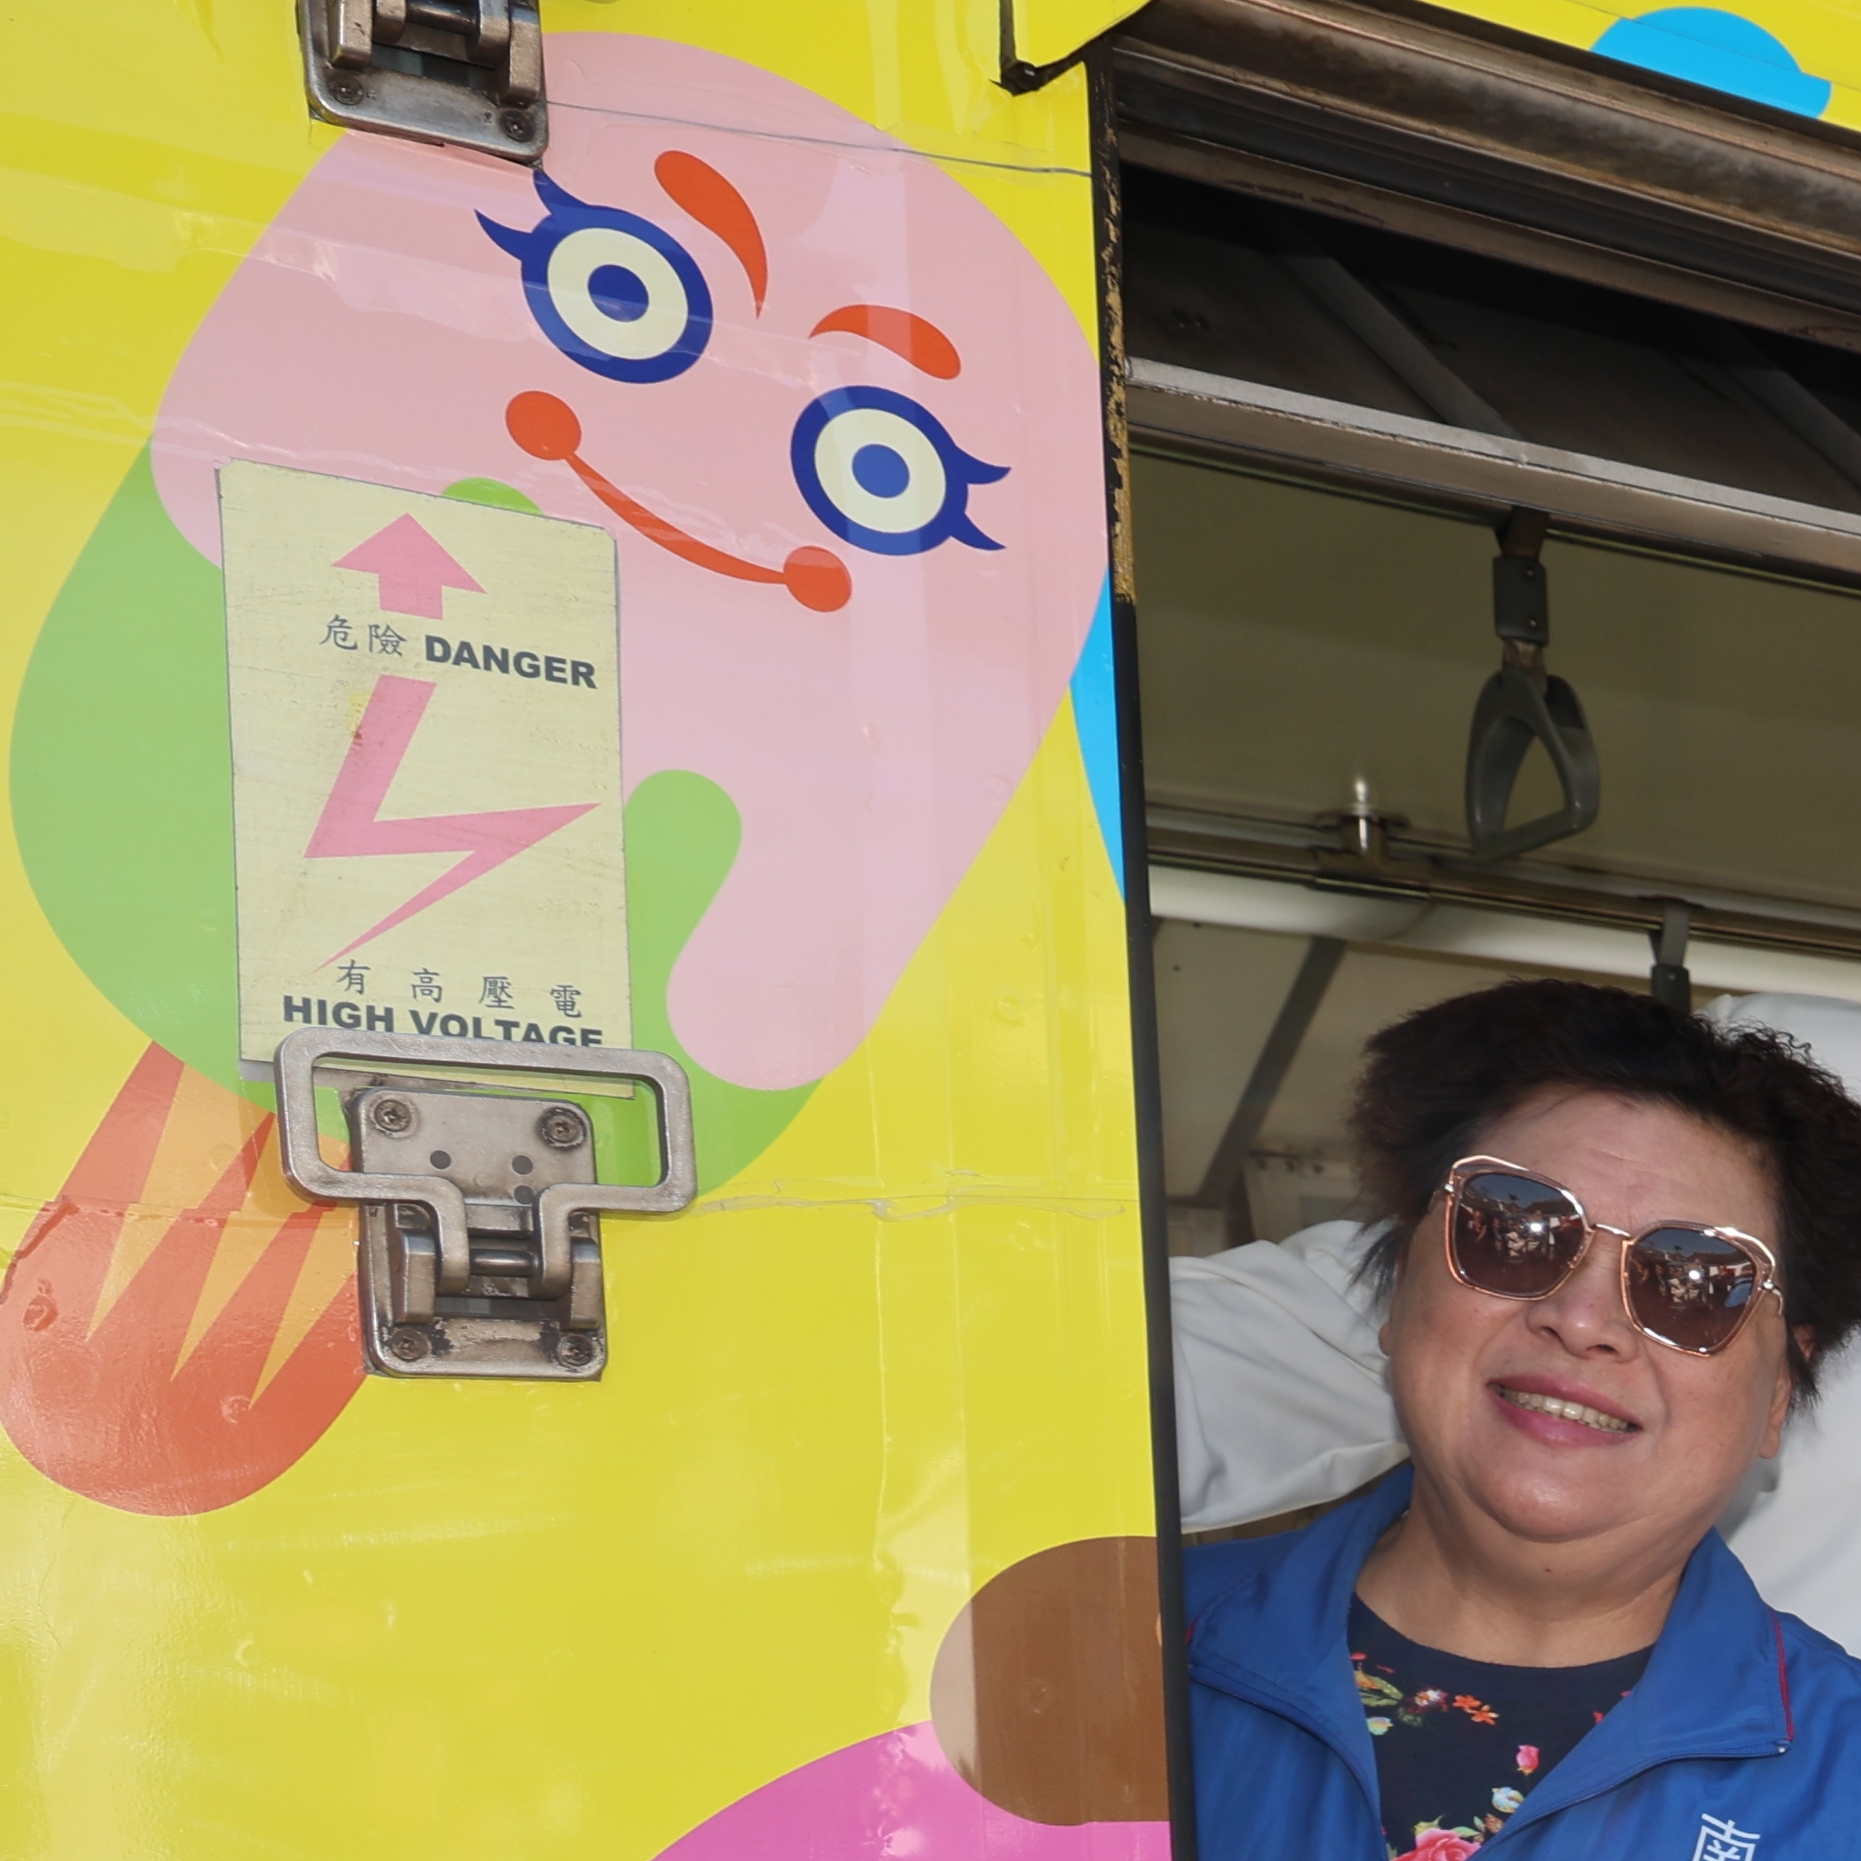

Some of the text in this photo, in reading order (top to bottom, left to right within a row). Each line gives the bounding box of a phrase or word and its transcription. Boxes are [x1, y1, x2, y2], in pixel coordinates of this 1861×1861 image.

[319, 614, 407, 657] 危險
[425, 635, 598, 689] DANGER
[337, 958, 583, 1018] 有高壓電
[283, 995, 603, 1047] HIGH VOLTAGE
